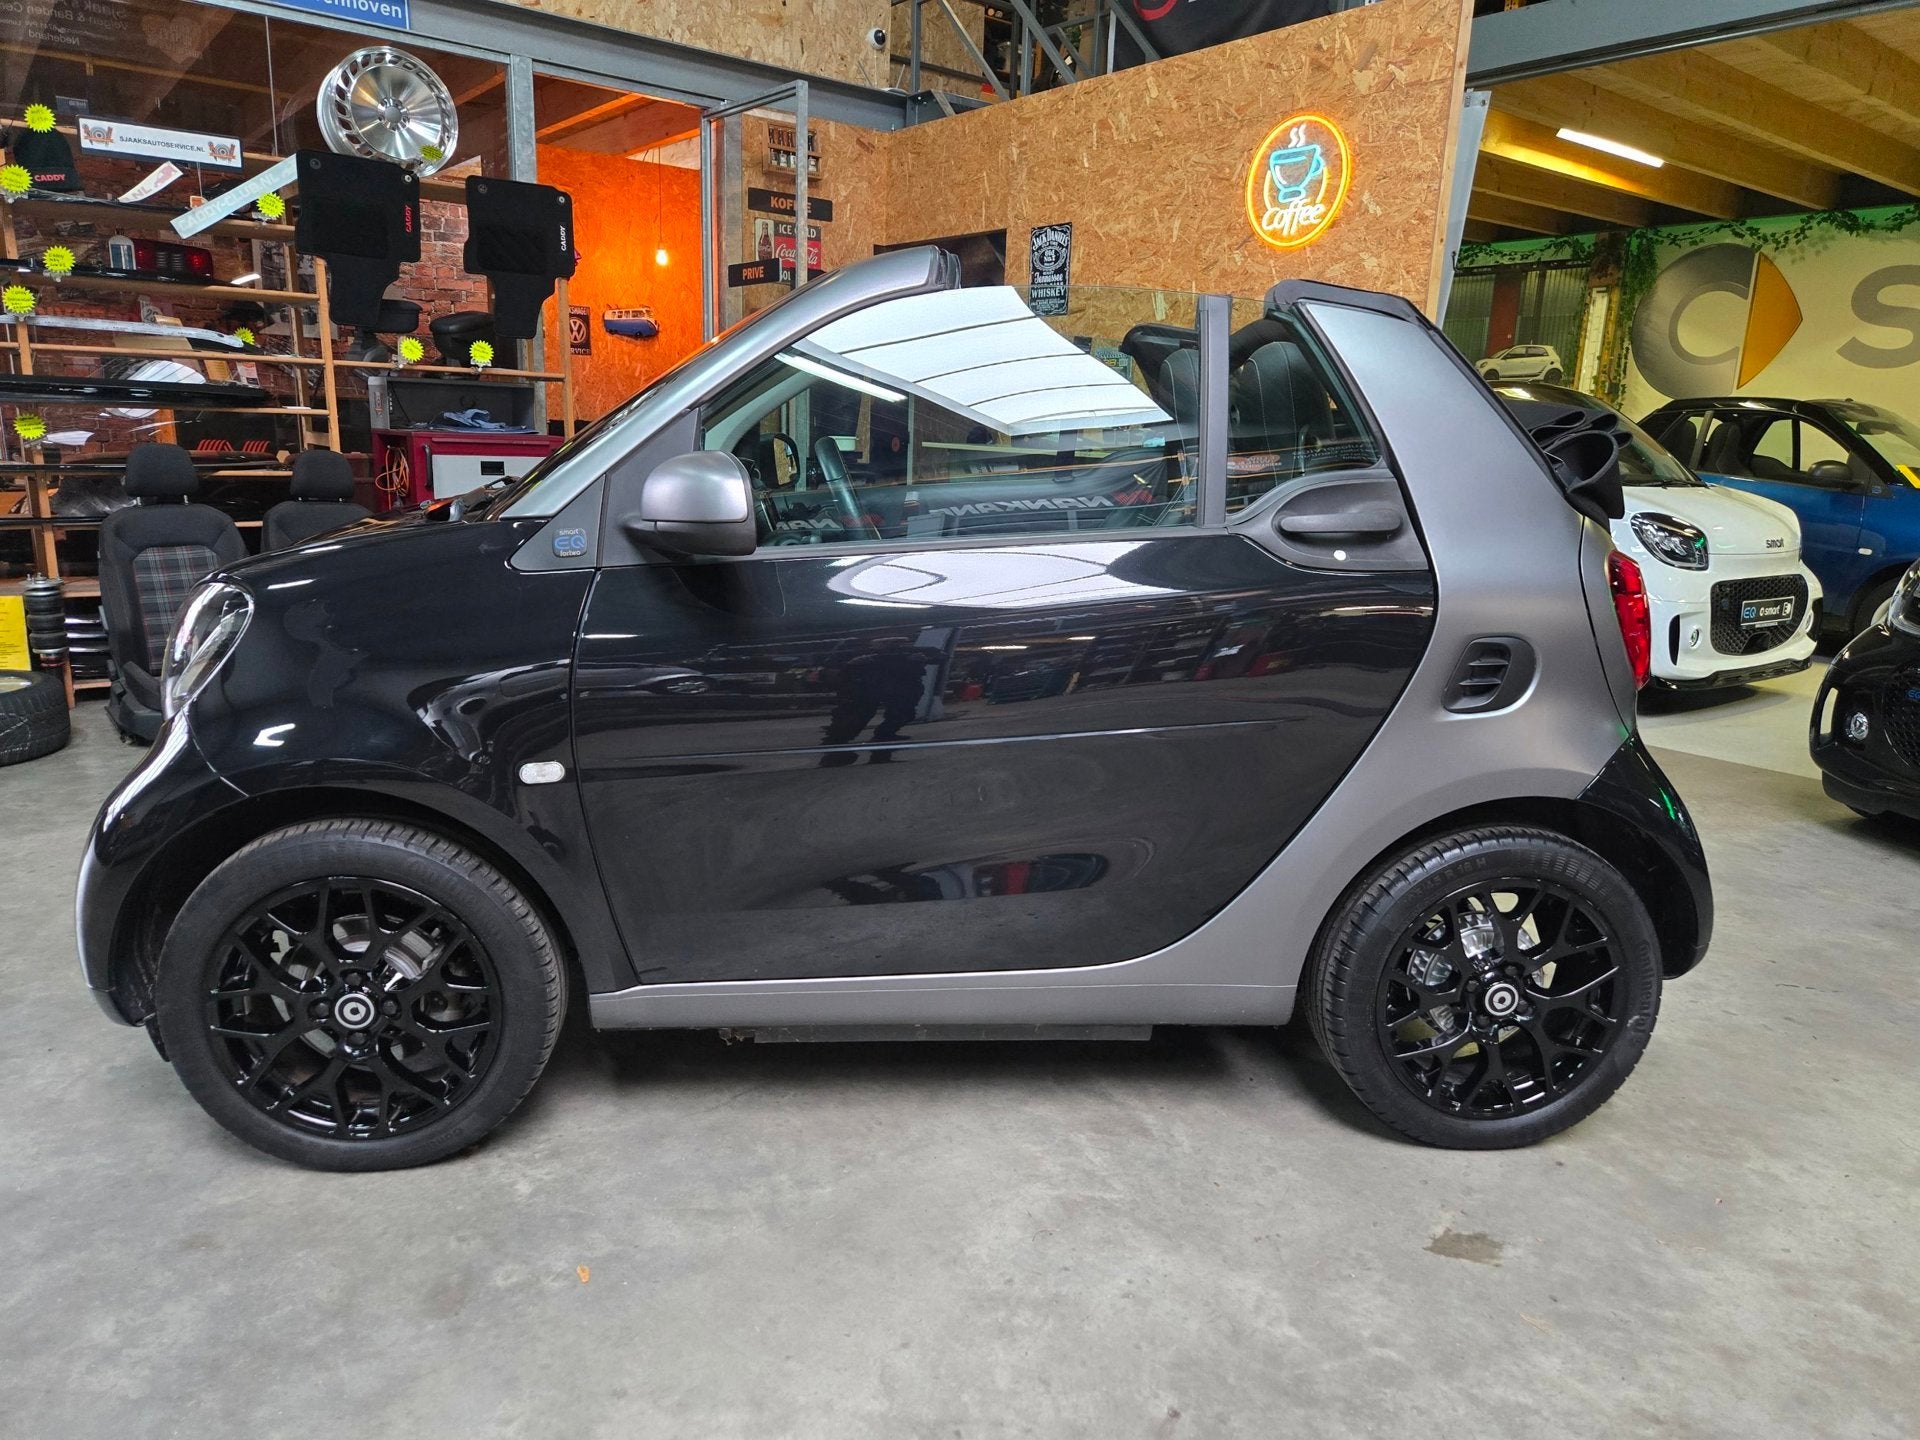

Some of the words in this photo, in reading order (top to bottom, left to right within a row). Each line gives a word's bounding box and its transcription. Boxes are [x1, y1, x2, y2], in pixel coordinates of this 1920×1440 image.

[119, 135, 205, 153] SJAAKSAUTOSERVICE.NL
[34, 173, 65, 182] CADDY
[770, 196, 812, 213] KOFE
[779, 224, 792, 235] ICE
[742, 266, 764, 280] PRIVE
[1031, 287, 1065, 298] WHISKEY
[555, 535, 585, 549] EQ
[1766, 537, 1784, 548] smart
[1743, 606, 1757, 618] EQ
[1765, 605, 1780, 616] smart
